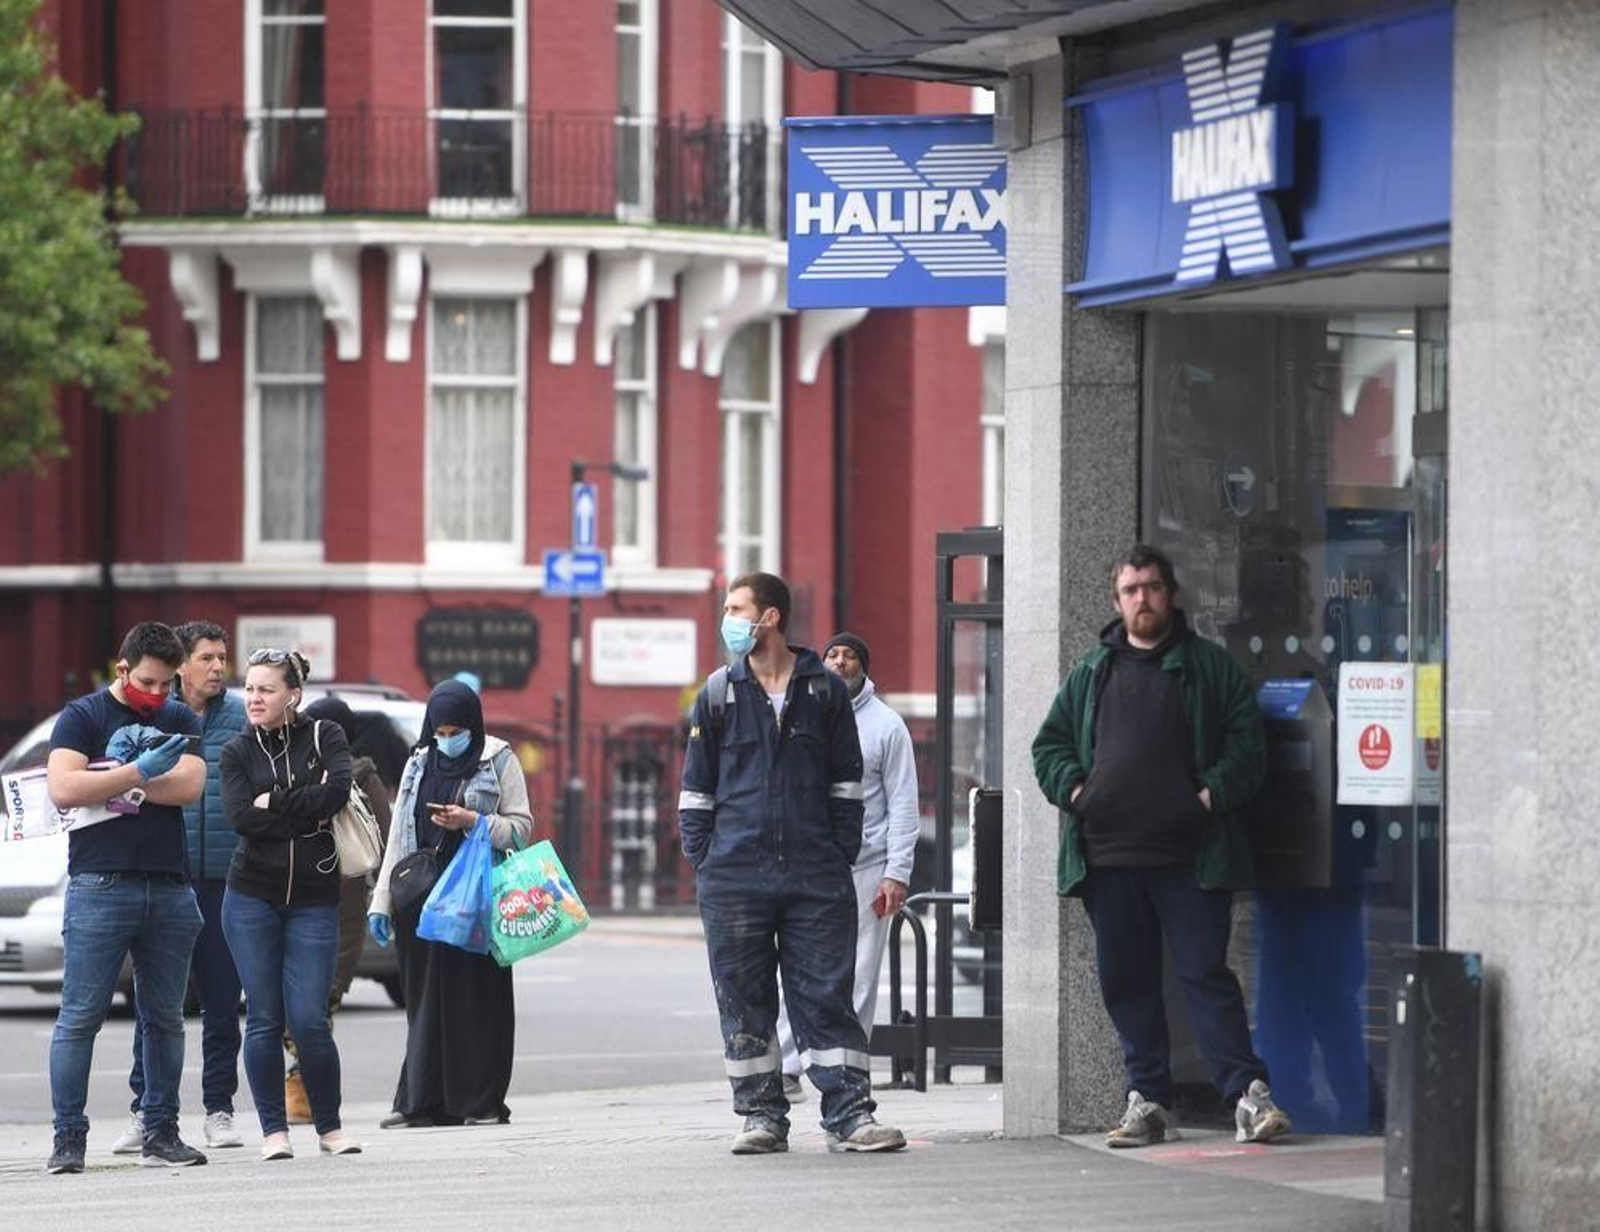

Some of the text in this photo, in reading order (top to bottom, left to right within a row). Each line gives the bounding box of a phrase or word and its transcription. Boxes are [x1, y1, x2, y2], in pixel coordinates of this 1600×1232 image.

[1171, 109, 1273, 203] HALIFAX
[795, 189, 1007, 235] HALIFAX
[1348, 677, 1404, 690] COVID-19
[500, 894, 529, 915] COOL
[500, 905, 558, 936] CUCUMBER
